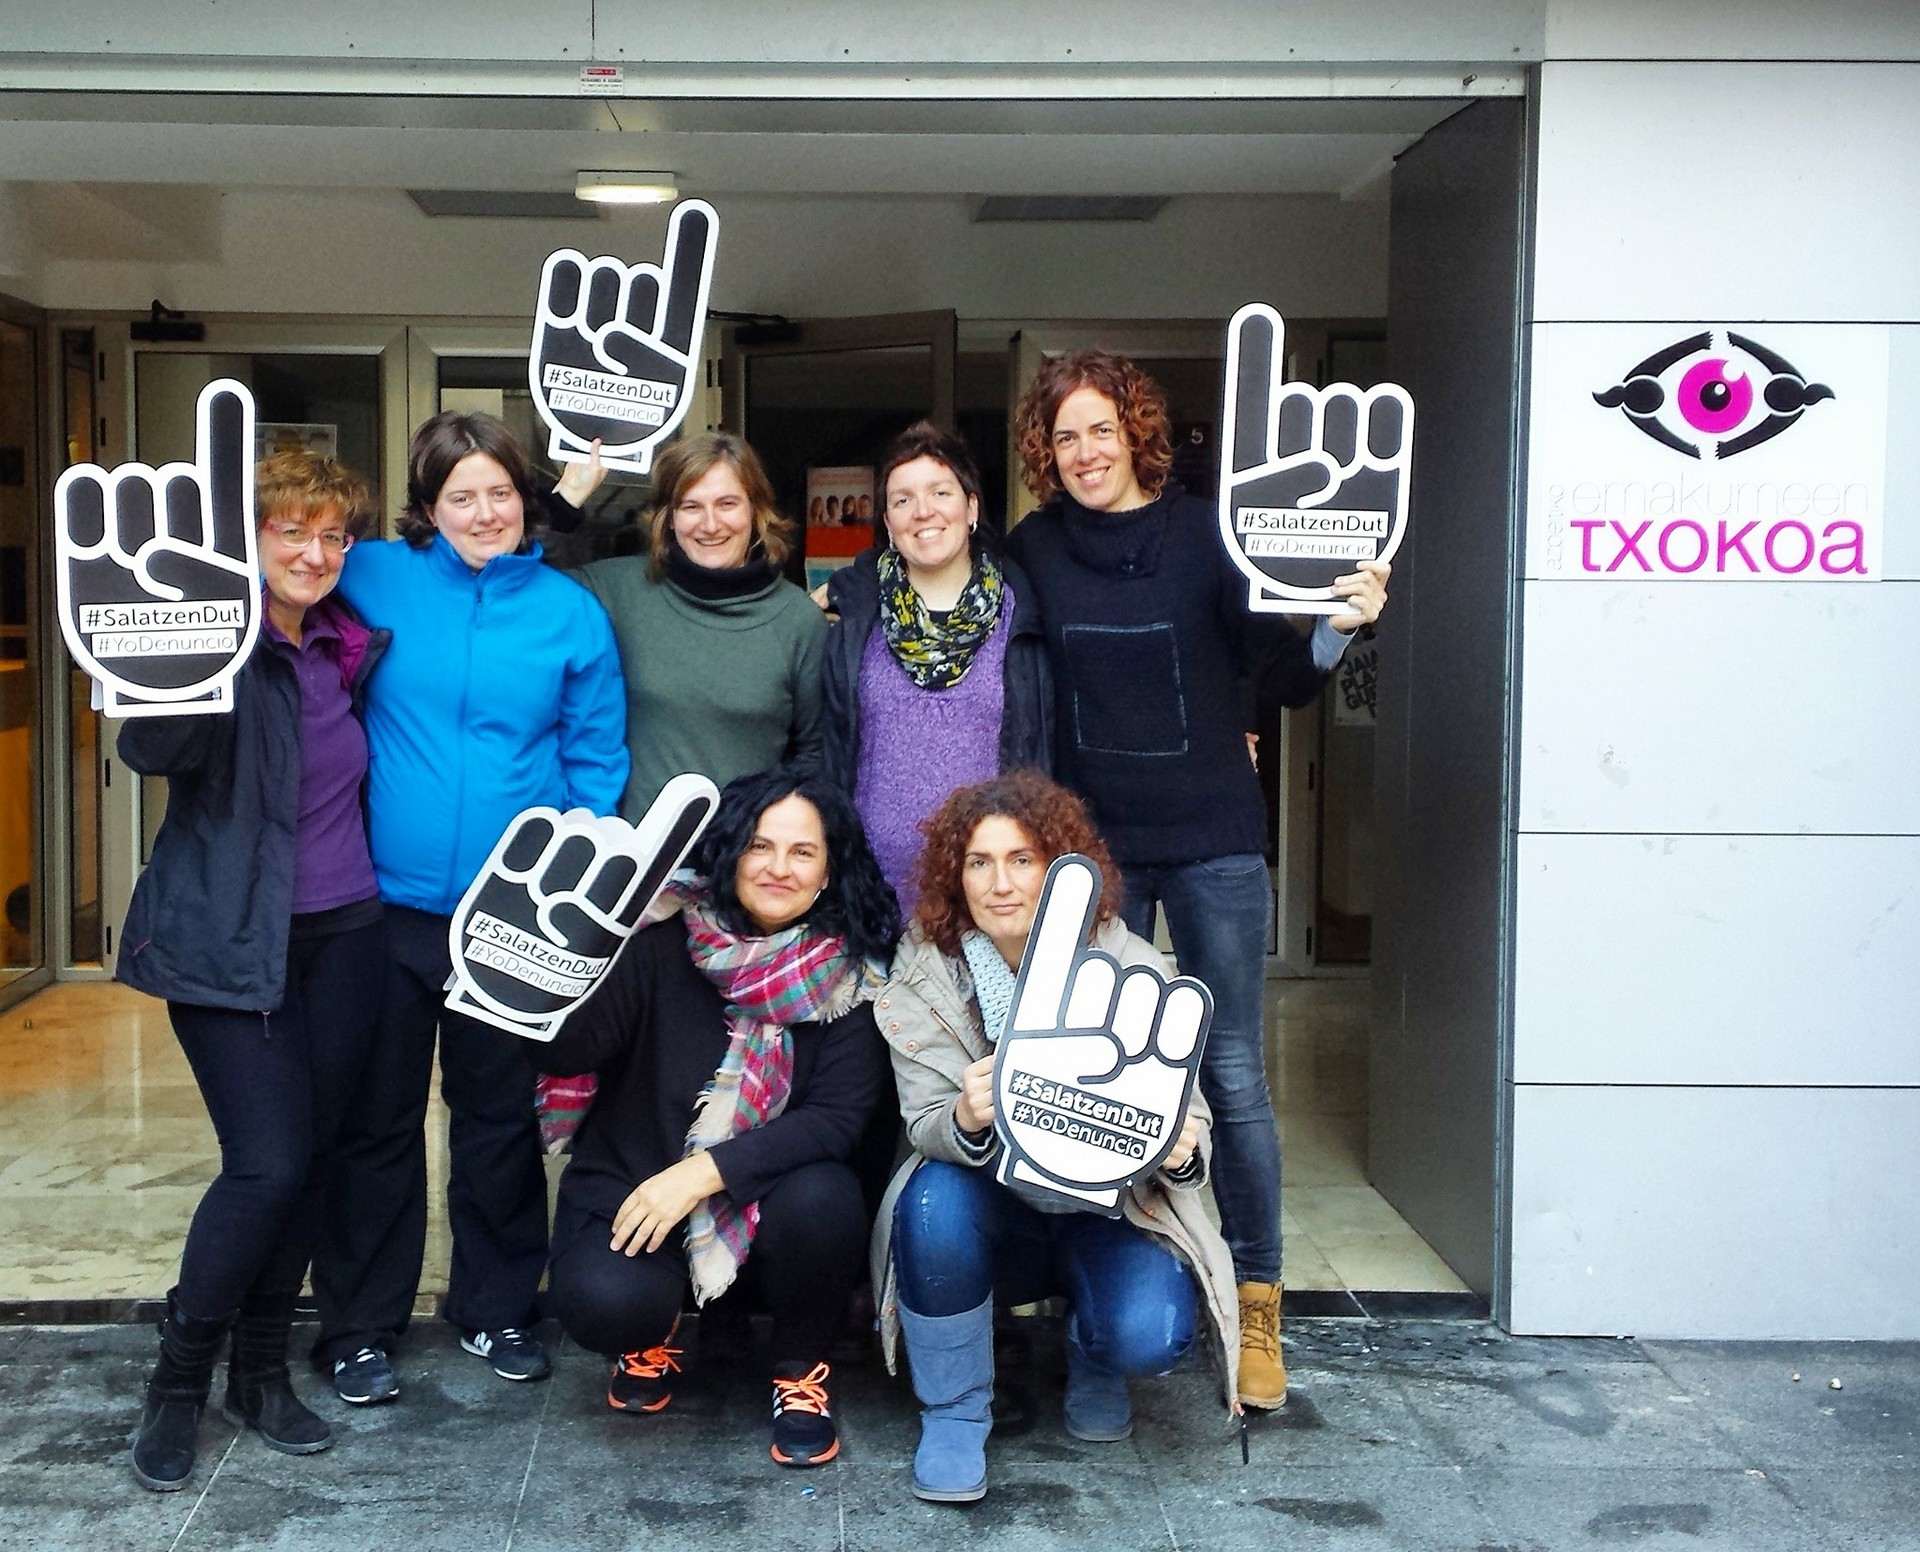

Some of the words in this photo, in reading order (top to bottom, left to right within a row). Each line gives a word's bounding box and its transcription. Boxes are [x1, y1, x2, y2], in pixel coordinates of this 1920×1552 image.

[548, 368, 672, 403] #SalatzenDut
[553, 392, 661, 423] #YoDenuncio
[1191, 430, 1204, 444] 5
[1572, 471, 1869, 516] emakumeen
[1242, 512, 1383, 532] #SalatzenDut
[1250, 538, 1374, 556] #YoDenuncio
[86, 605, 241, 628] #SalatzenDut
[98, 632, 234, 653] #YoDenuncio
[473, 917, 604, 975] #SalatzenDut
[470, 943, 584, 995] #YoDenuncio
[1011, 1072, 1162, 1138] #SalatzenDut
[1013, 1103, 1145, 1160] #YoDenuncio
